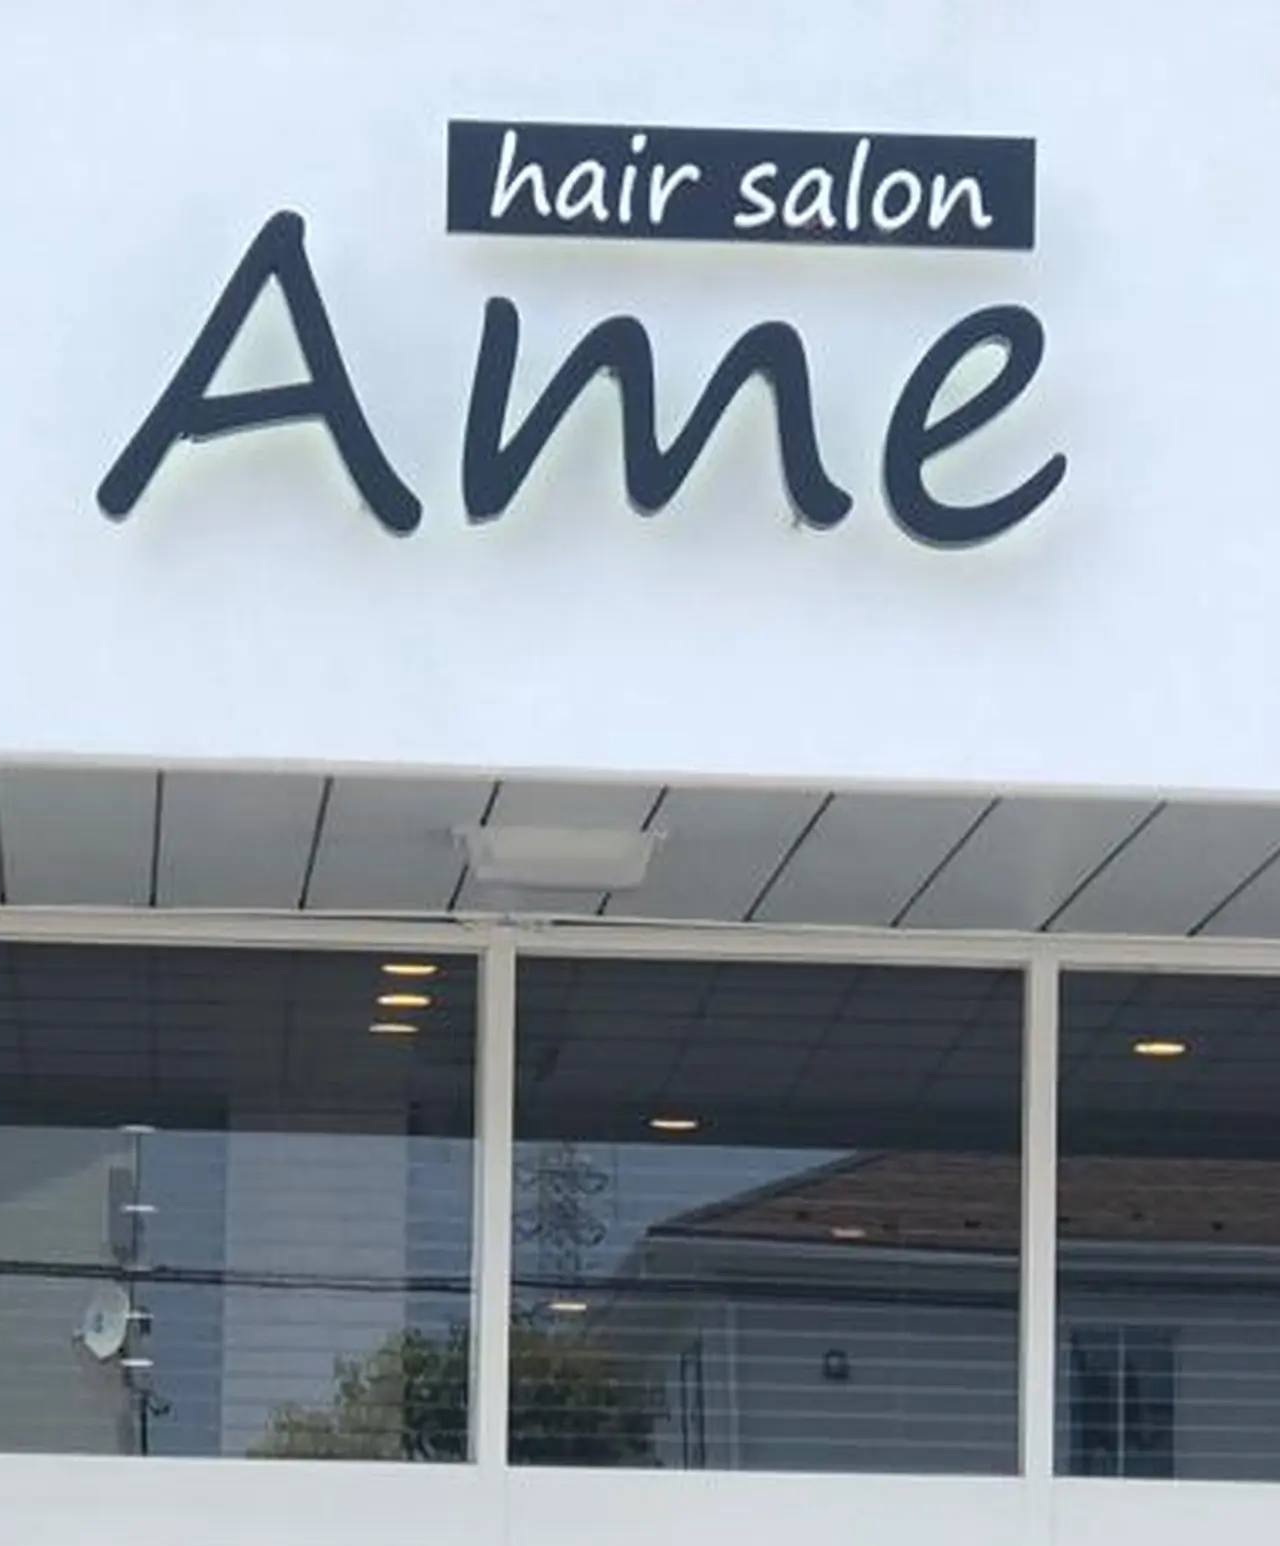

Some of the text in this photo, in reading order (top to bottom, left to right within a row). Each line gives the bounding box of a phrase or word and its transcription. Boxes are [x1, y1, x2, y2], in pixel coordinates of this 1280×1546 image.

[490, 129, 994, 233] hair salon
[95, 208, 1067, 547] Ame
